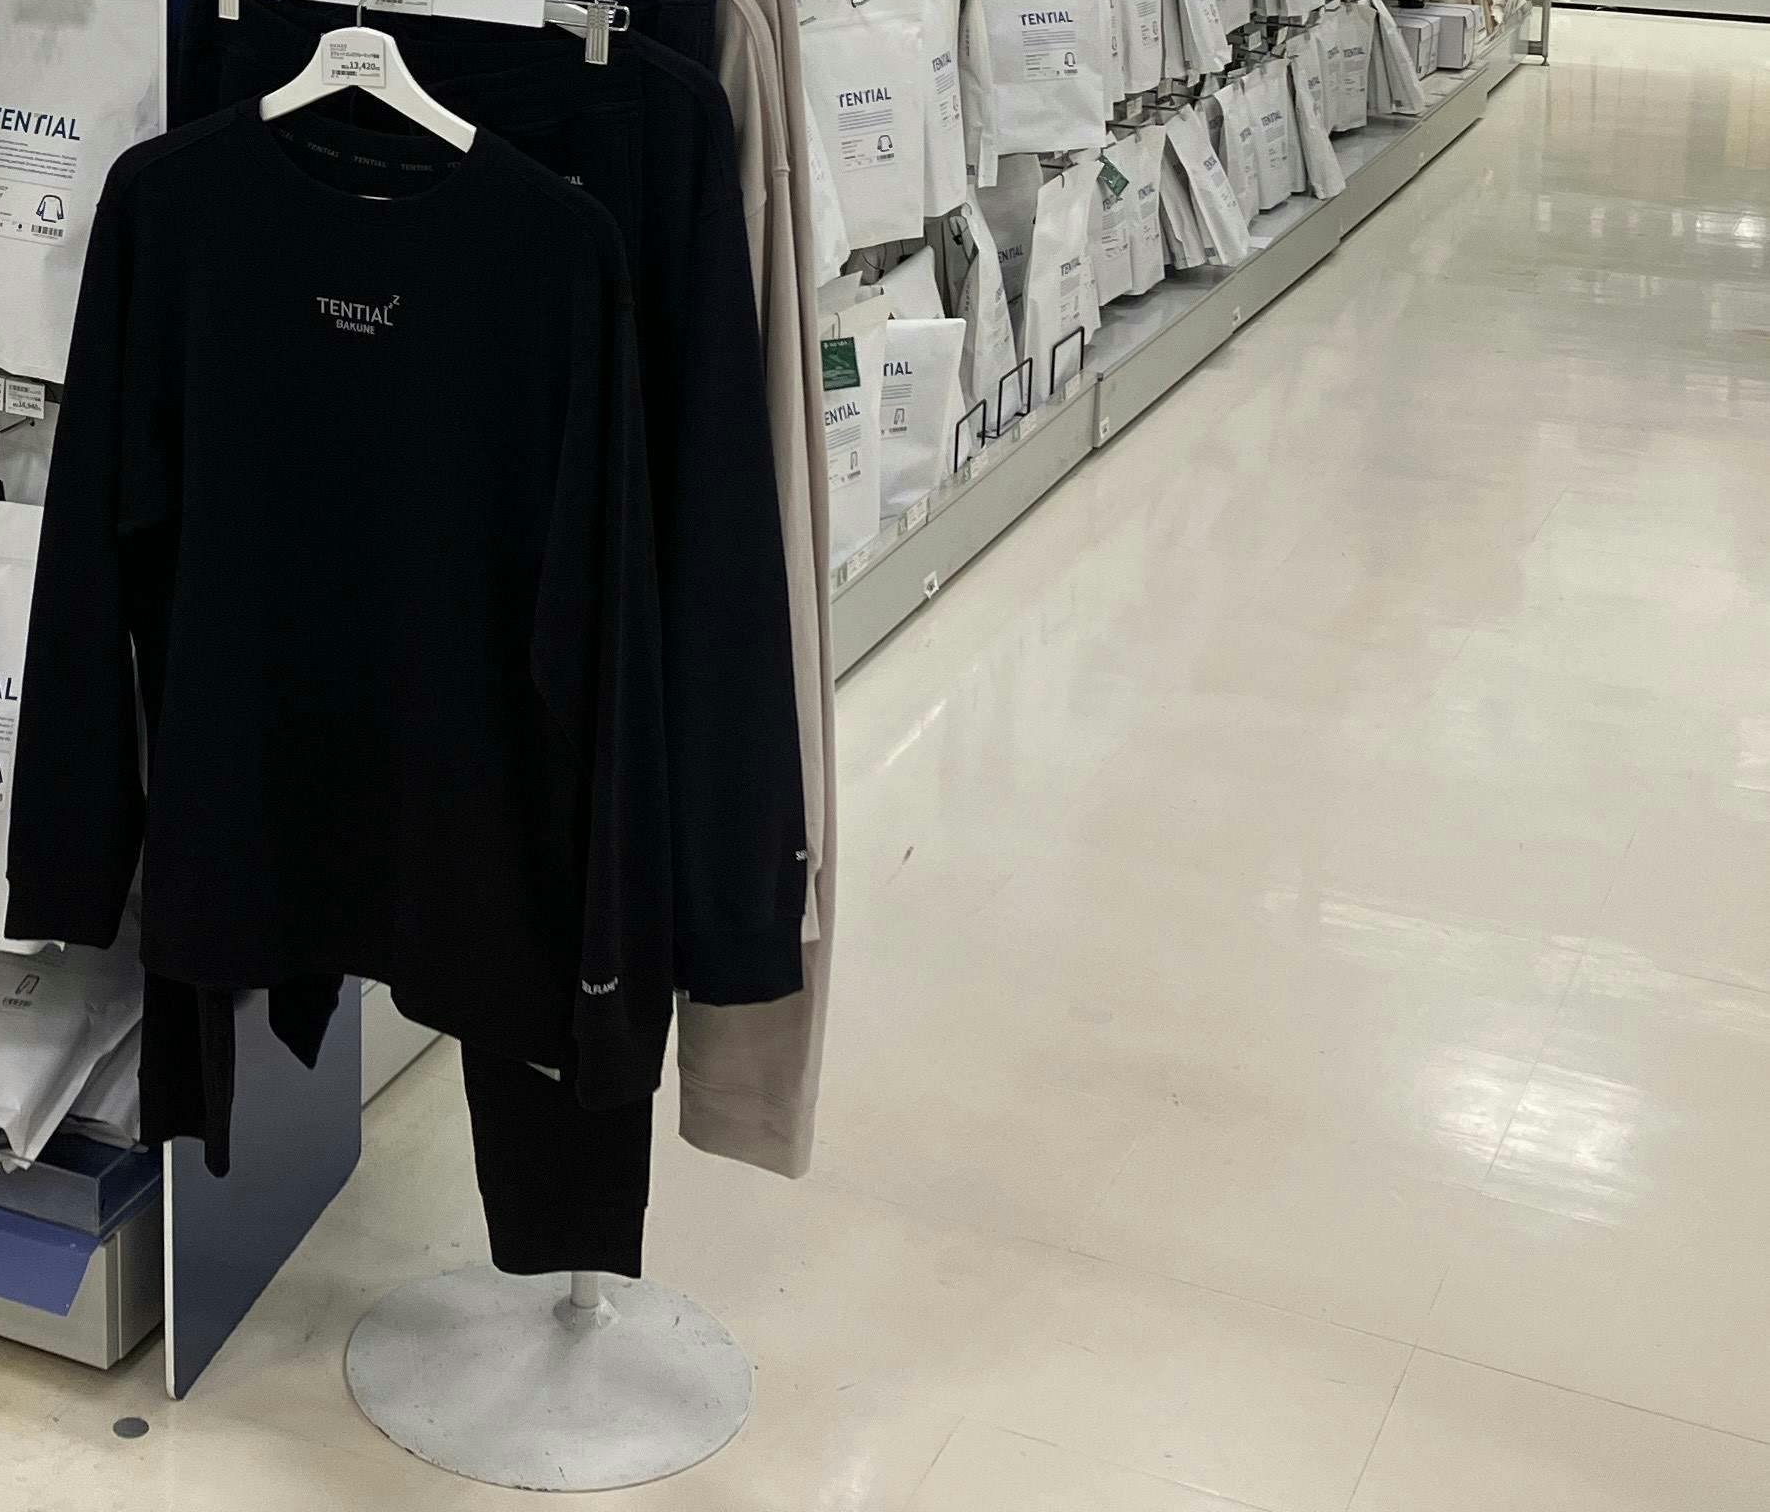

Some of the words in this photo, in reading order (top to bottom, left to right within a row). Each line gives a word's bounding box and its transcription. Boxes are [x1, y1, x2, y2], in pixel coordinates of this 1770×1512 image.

[1021, 11, 1073, 26] TENTIAL
[839, 88, 892, 108] TENTIAL
[316, 297, 393, 326] TENTIAL
[336, 319, 375, 335] BAKUNE
